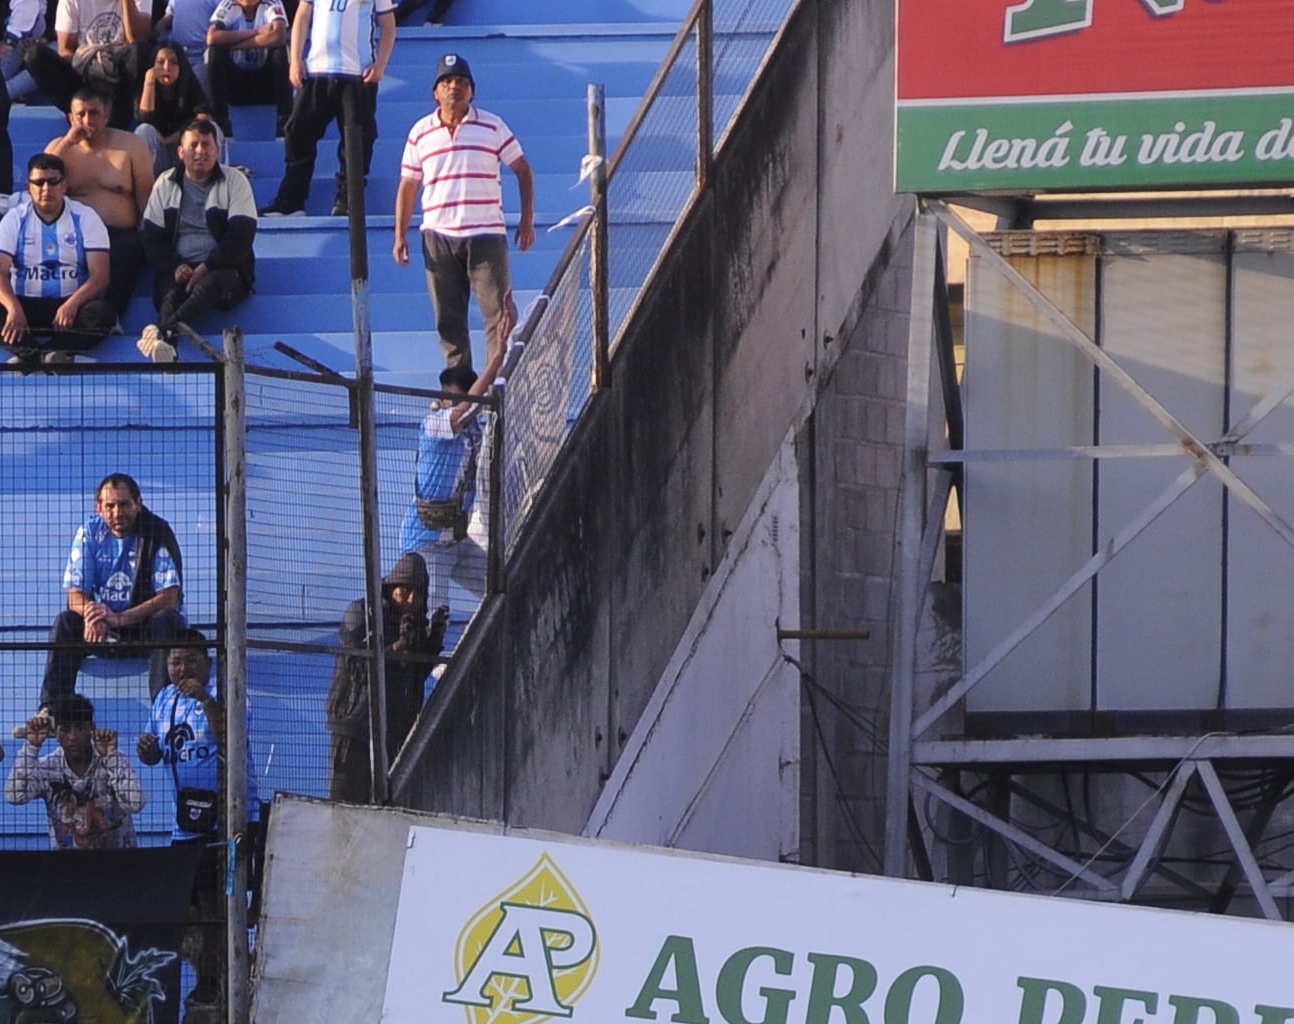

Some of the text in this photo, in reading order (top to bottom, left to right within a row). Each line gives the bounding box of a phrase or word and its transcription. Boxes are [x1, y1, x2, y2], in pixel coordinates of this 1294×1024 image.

[937, 117, 1294, 170] Llená tu vida d
[25, 266, 79, 281] Macro
